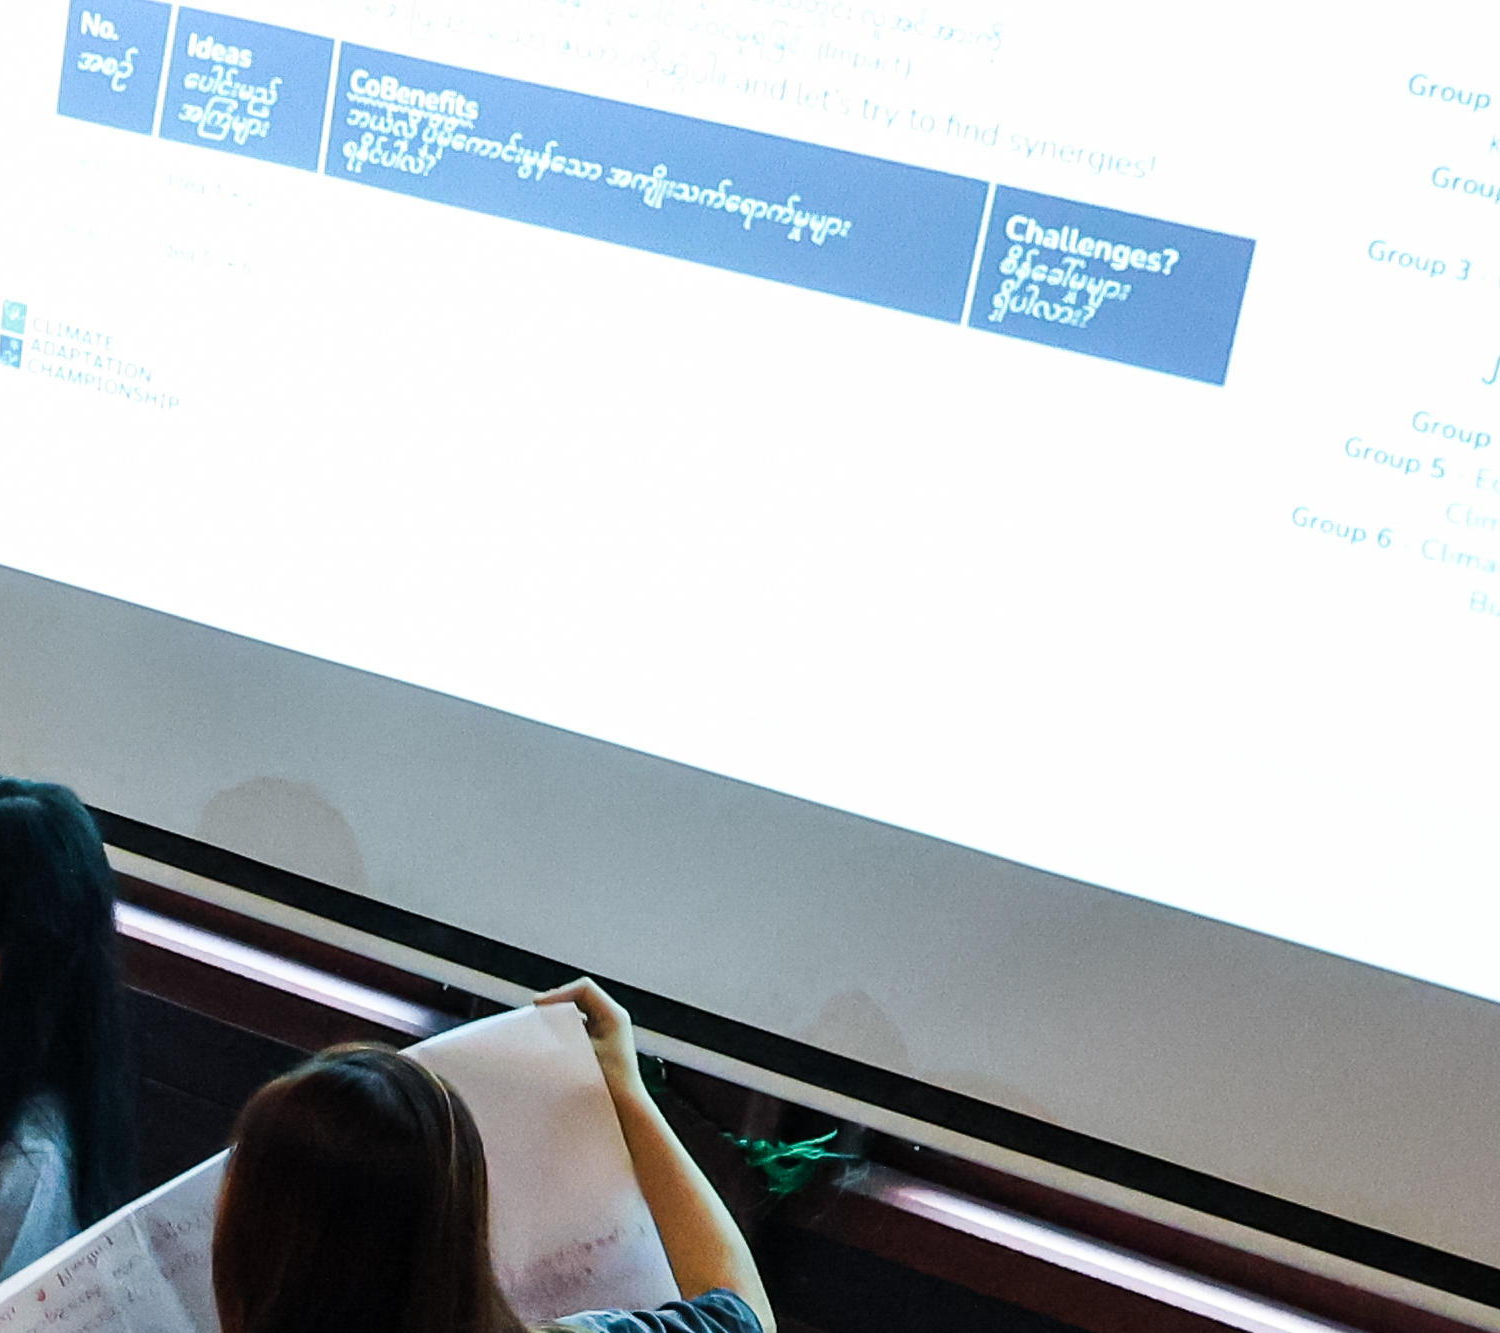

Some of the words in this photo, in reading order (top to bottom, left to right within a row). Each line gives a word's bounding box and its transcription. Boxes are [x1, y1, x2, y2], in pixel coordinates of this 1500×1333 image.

[74, 10, 120, 42] No.
[185, 31, 253, 72] Ideas
[346, 62, 480, 128] CoBenefits
[1407, 72, 1493, 113] Group
[735, 77, 789, 102] and
[862, 97, 900, 129] try
[909, 107, 937, 134] to
[945, 113, 1001, 148] find
[1009, 133, 1158, 180] synergies!
[1004, 213, 1181, 276] Challenges?
[1366, 238, 1448, 279] Group
[1455, 258, 1473, 282] 3
[32, 317, 114, 352] CLIMATE
[30, 337, 153, 384] ADAPTATION
[27, 358, 181, 410] CHAMPIONSHIP
[1411, 409, 1493, 451] Group
[1343, 435, 1422, 476] Group
[1430, 456, 1447, 480] 5
[1290, 505, 1369, 545] Group
[1376, 526, 1393, 549] 6
